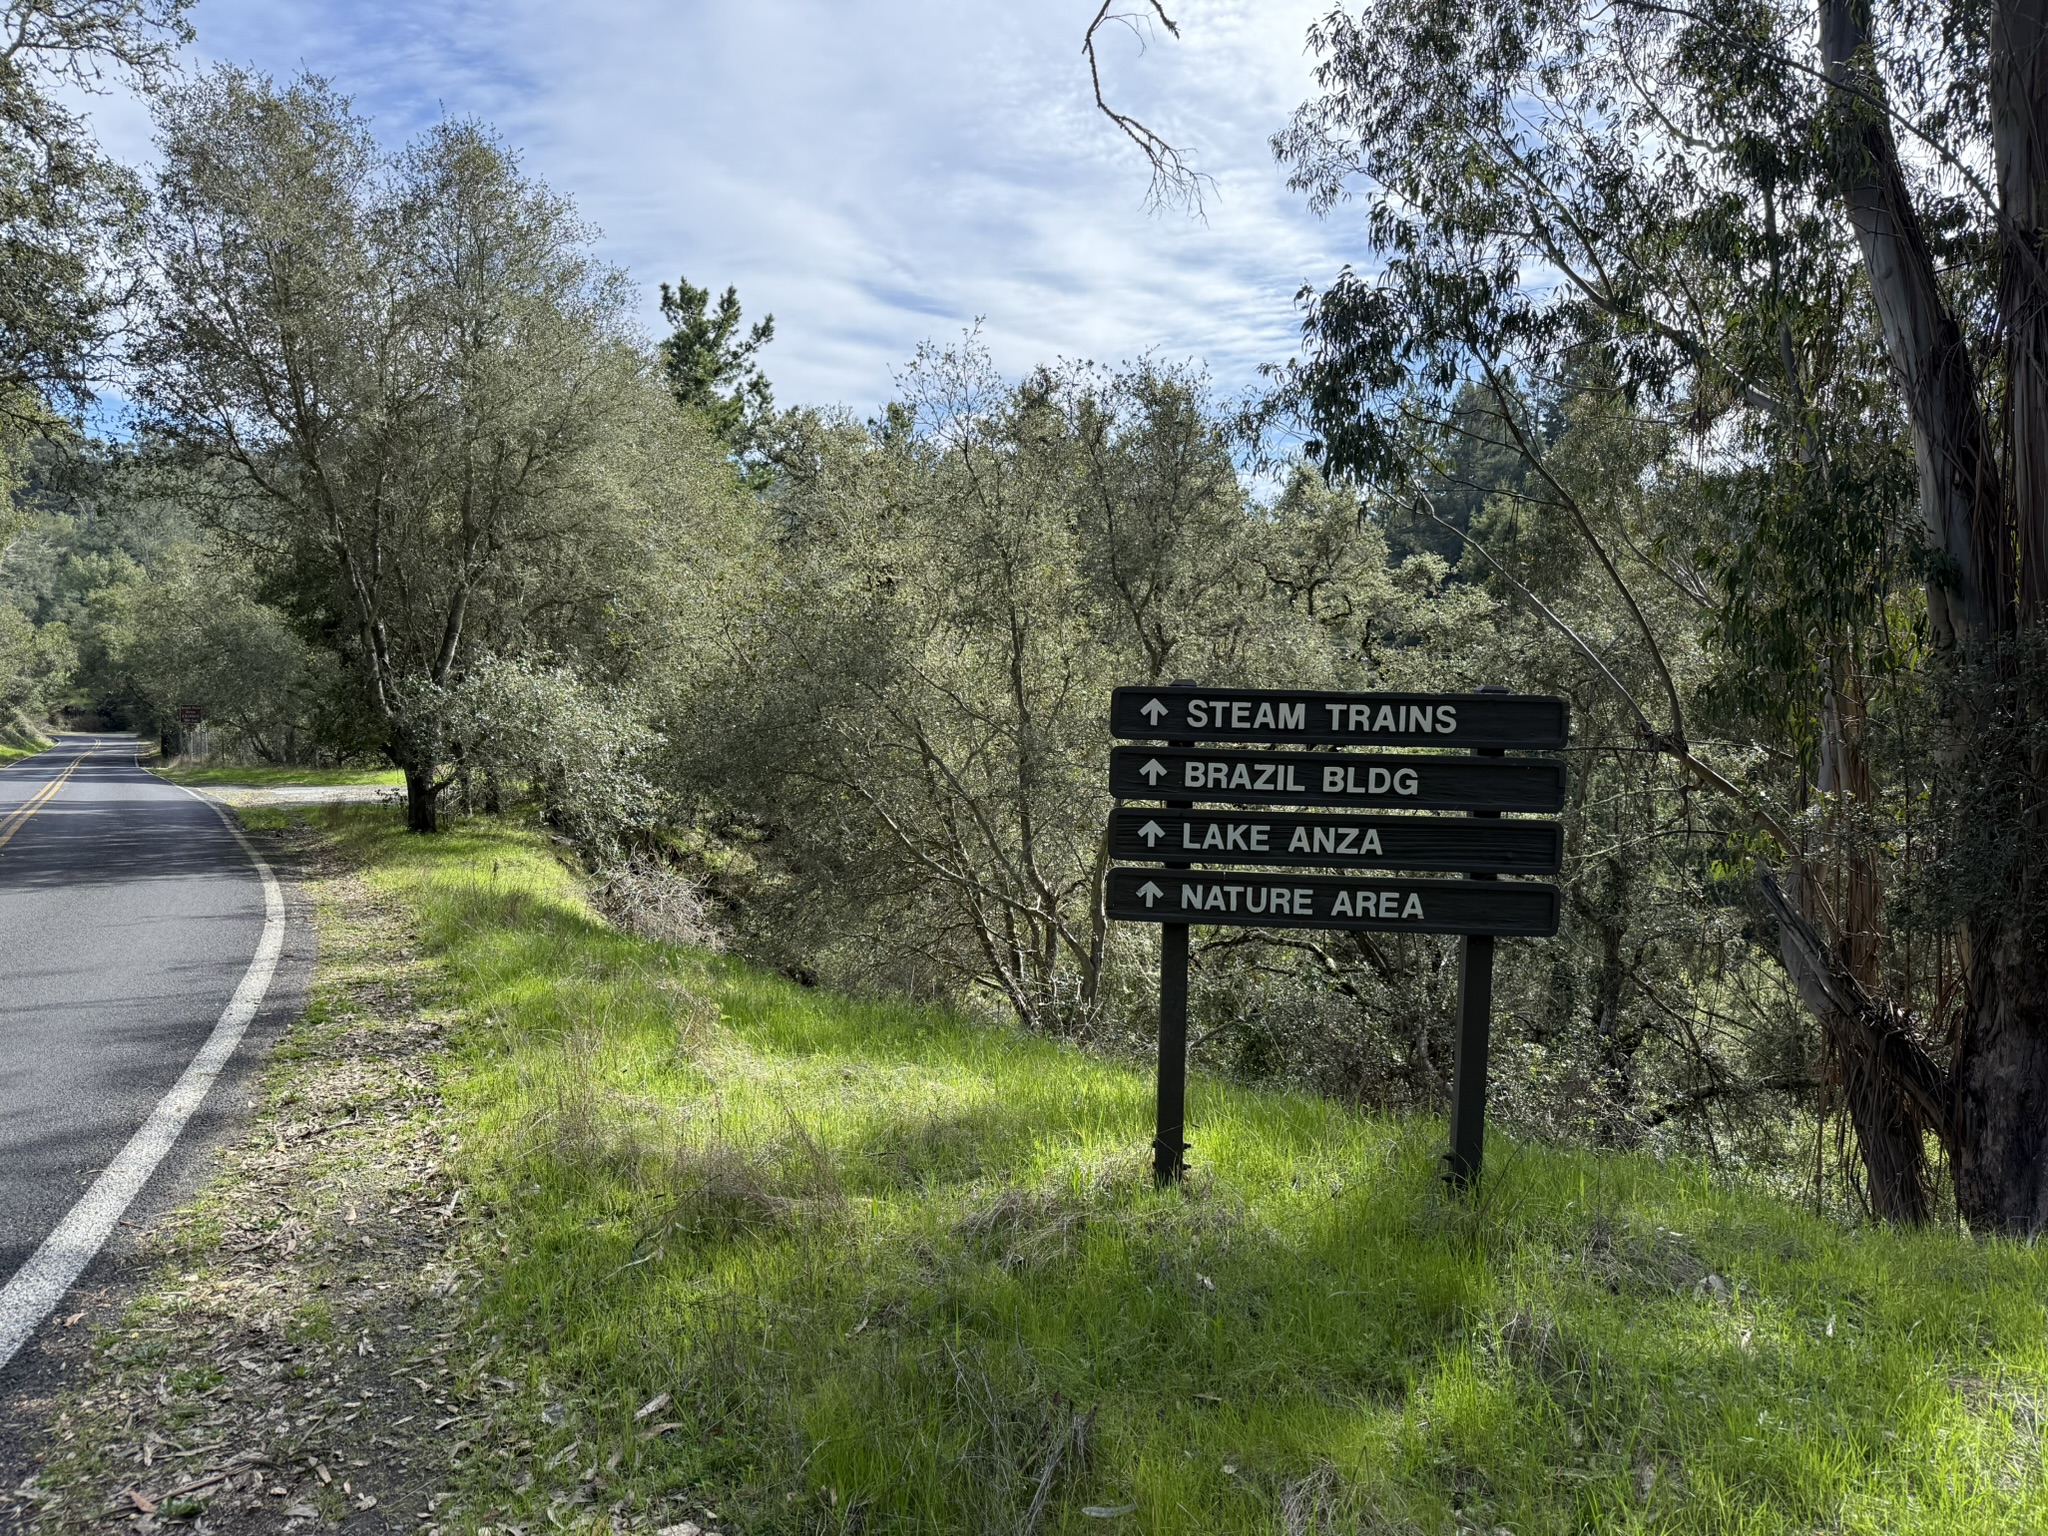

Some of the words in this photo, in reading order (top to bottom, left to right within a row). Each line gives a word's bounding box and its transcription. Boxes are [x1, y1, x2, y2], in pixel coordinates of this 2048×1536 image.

[1186, 699, 1306, 730] STEAM
[1325, 703, 1457, 734] TRAINS
[1184, 761, 1306, 792] BRAZIL
[1322, 766, 1419, 795] BLDG
[1182, 822, 1270, 851] LAKE
[1288, 826, 1383, 855] ANZA
[1181, 884, 1314, 915] NATURE
[1330, 890, 1425, 919] AREA
